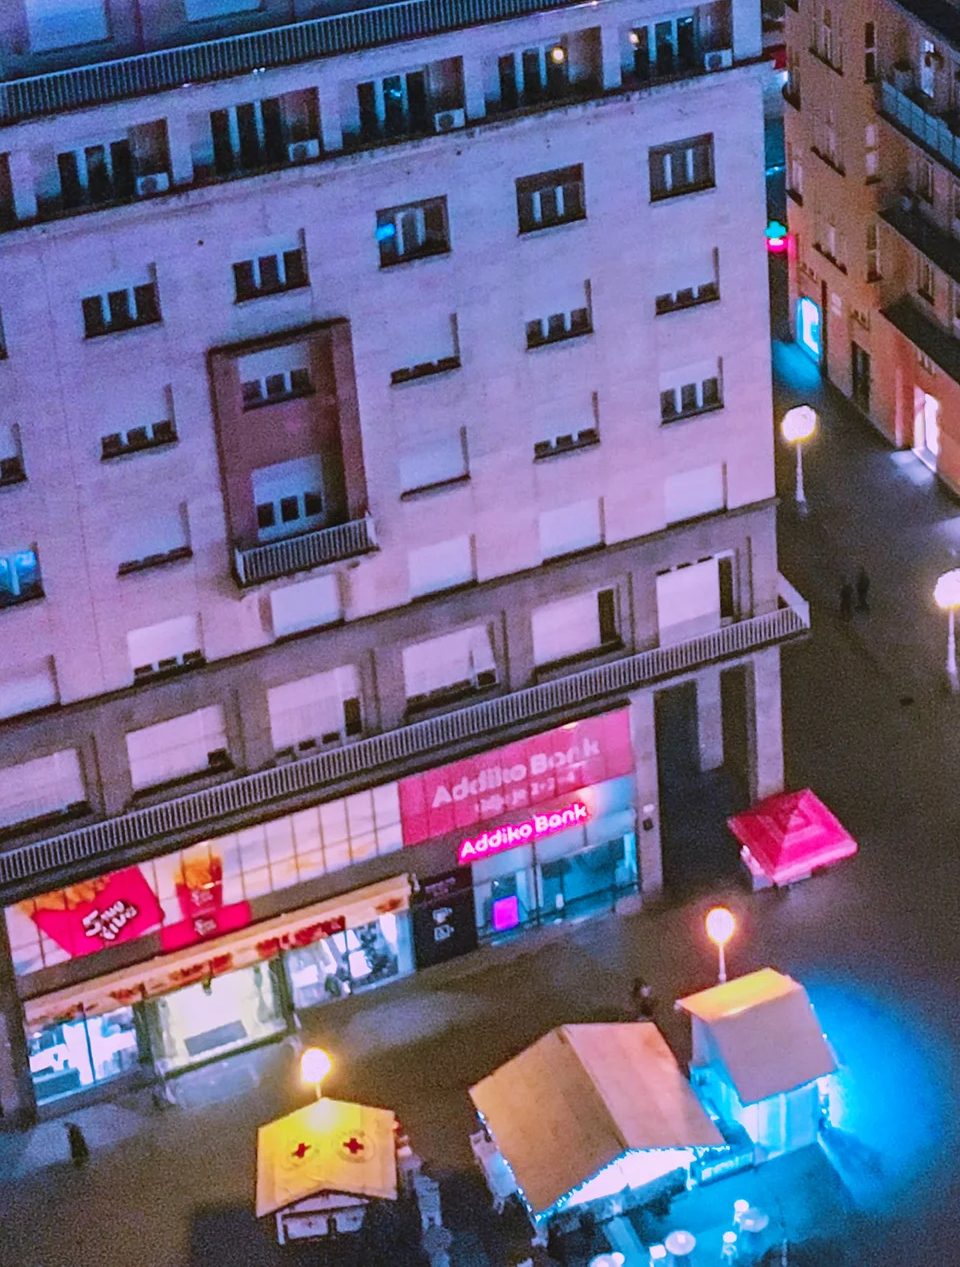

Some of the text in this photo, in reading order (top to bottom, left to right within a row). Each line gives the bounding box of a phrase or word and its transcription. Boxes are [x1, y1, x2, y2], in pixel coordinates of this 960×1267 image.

[431, 763, 527, 808] Addiko
[530, 738, 600, 775] Bank
[460, 822, 532, 858] Addiko
[533, 803, 587, 833] Bank
